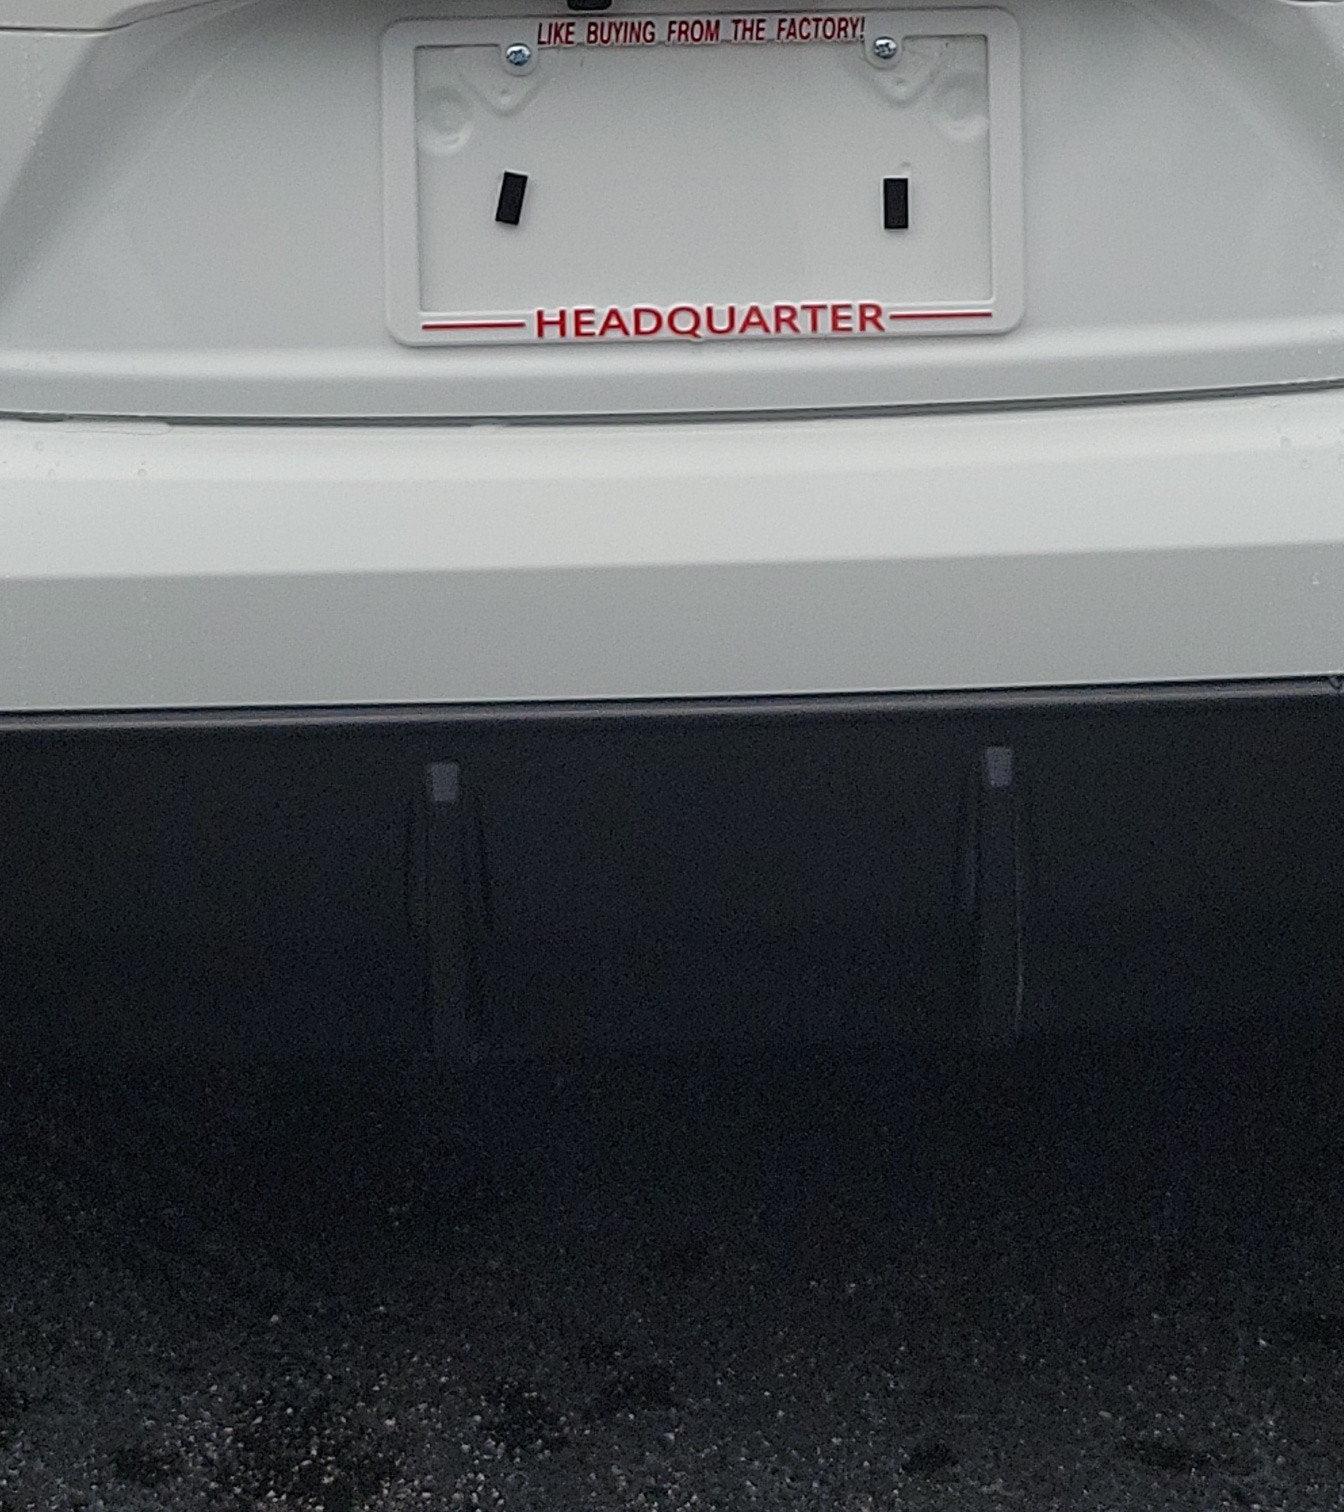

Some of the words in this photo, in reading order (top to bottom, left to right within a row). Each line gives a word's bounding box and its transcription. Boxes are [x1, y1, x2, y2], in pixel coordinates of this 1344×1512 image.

[536, 21, 576, 45] LIKE
[586, 20, 656, 44] BUYING
[667, 19, 721, 44] FROM
[731, 18, 766, 42] THE
[776, 16, 866, 41] FACTORY!
[535, 303, 886, 339] HEADQUARTER
